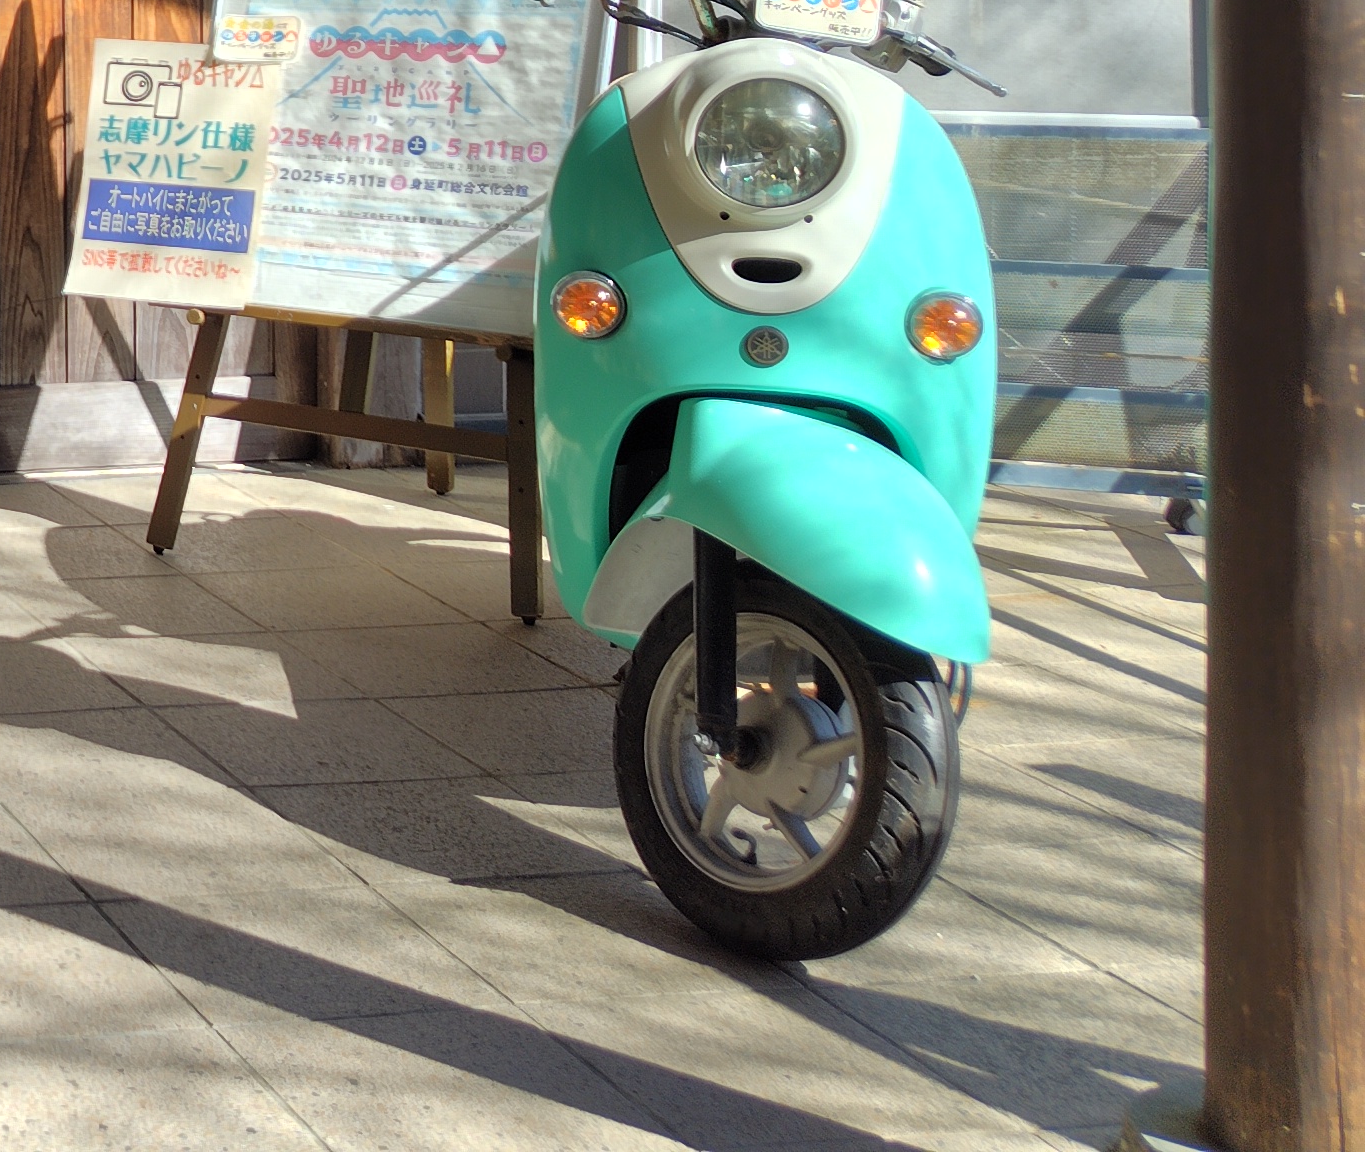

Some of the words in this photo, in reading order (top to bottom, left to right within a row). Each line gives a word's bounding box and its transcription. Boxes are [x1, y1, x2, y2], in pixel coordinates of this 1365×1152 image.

[329, 74, 482, 116] 聖地巡礼
[97, 114, 256, 152] 志摩リン仕様
[269, 126, 405, 156] 025年4月12日
[107, 184, 235, 216] オートバイにまたがって
